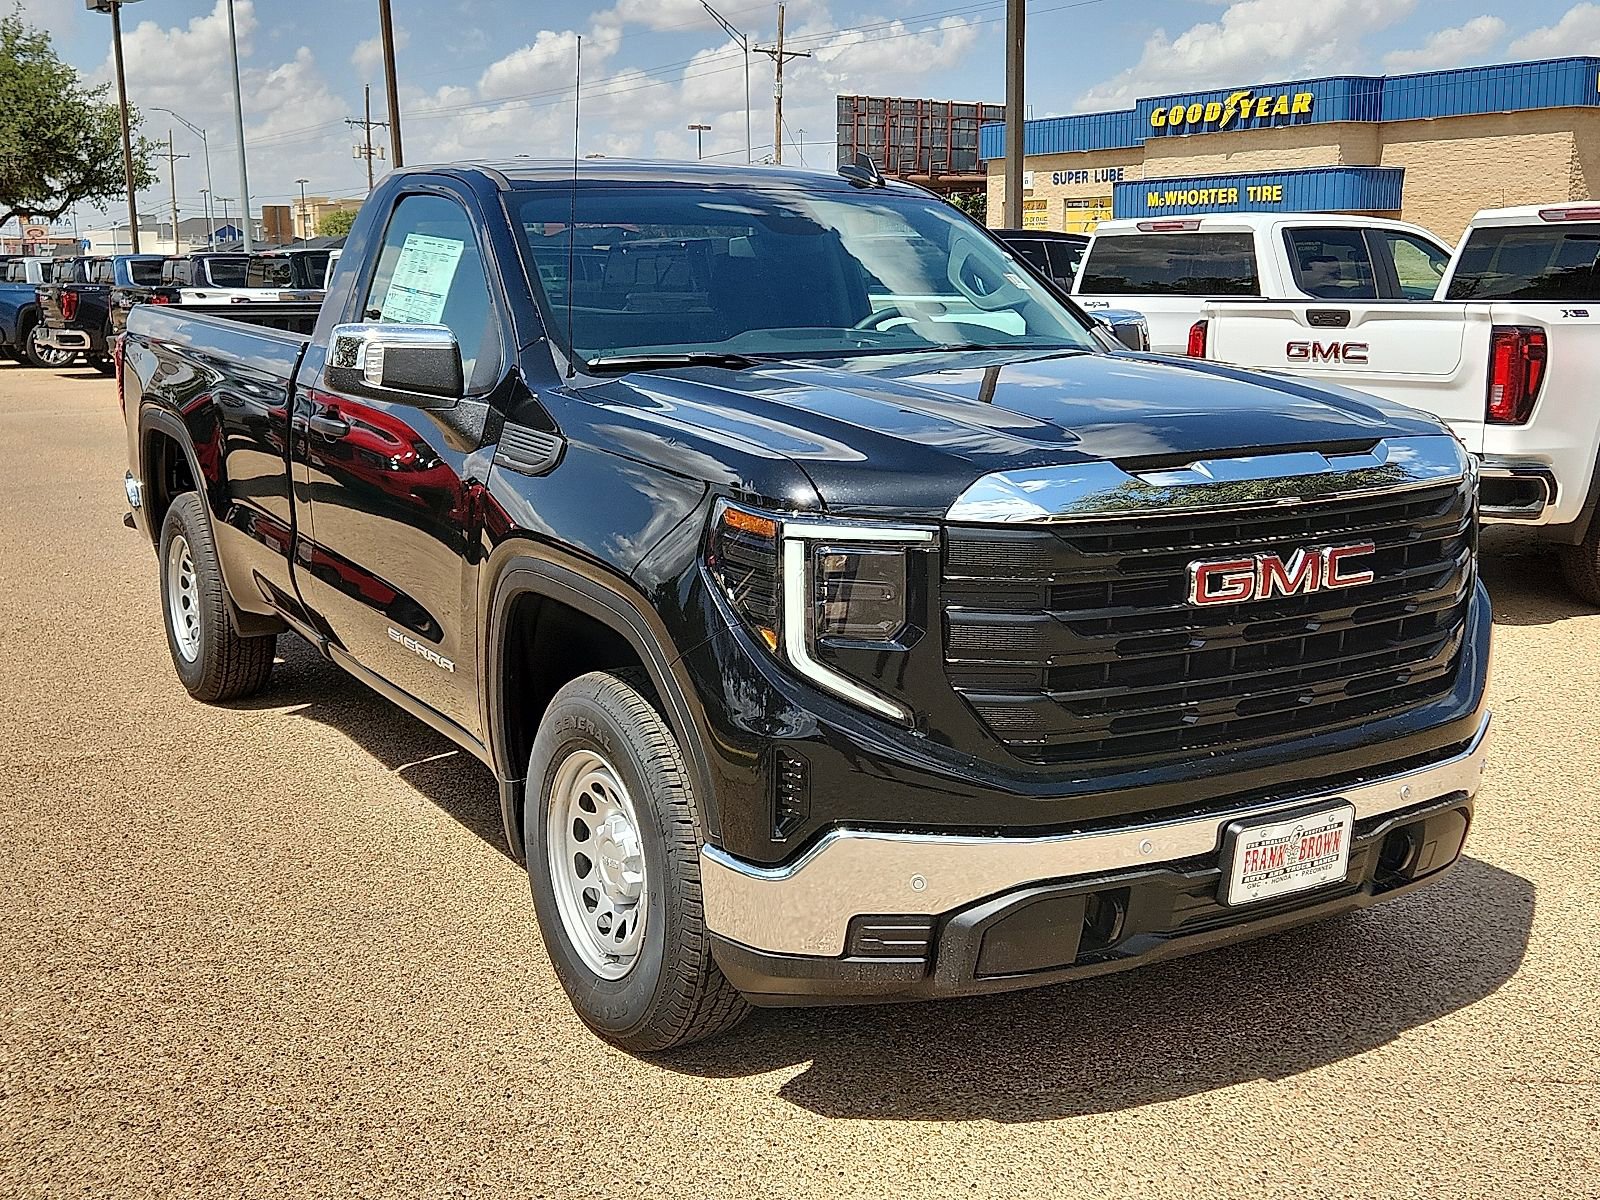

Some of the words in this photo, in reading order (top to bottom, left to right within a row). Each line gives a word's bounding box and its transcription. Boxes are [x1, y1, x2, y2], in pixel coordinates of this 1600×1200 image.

[1150, 92, 1314, 128] GOODYEAR
[1052, 170, 1089, 185] SUPER
[1094, 168, 1124, 183] LUBE
[1147, 187, 1238, 207] McWHORTER
[1247, 185, 1282, 202] TIRE
[1286, 341, 1369, 364] GMC
[1186, 540, 1375, 606] GMC
[387, 626, 455, 673] SIERRA
[554, 715, 611, 753] GENERAL
[1243, 844, 1288, 874] FRANK
[1299, 830, 1342, 860] BROWN
[1243, 874, 1266, 883] AUTO
[1268, 869, 1285, 878] AND
[1286, 863, 1312, 873] TRUCK
[1246, 881, 1261, 889] GMC
[1271, 874, 1292, 884] HONDA
[1301, 864, 1333, 877] PREOWNED
